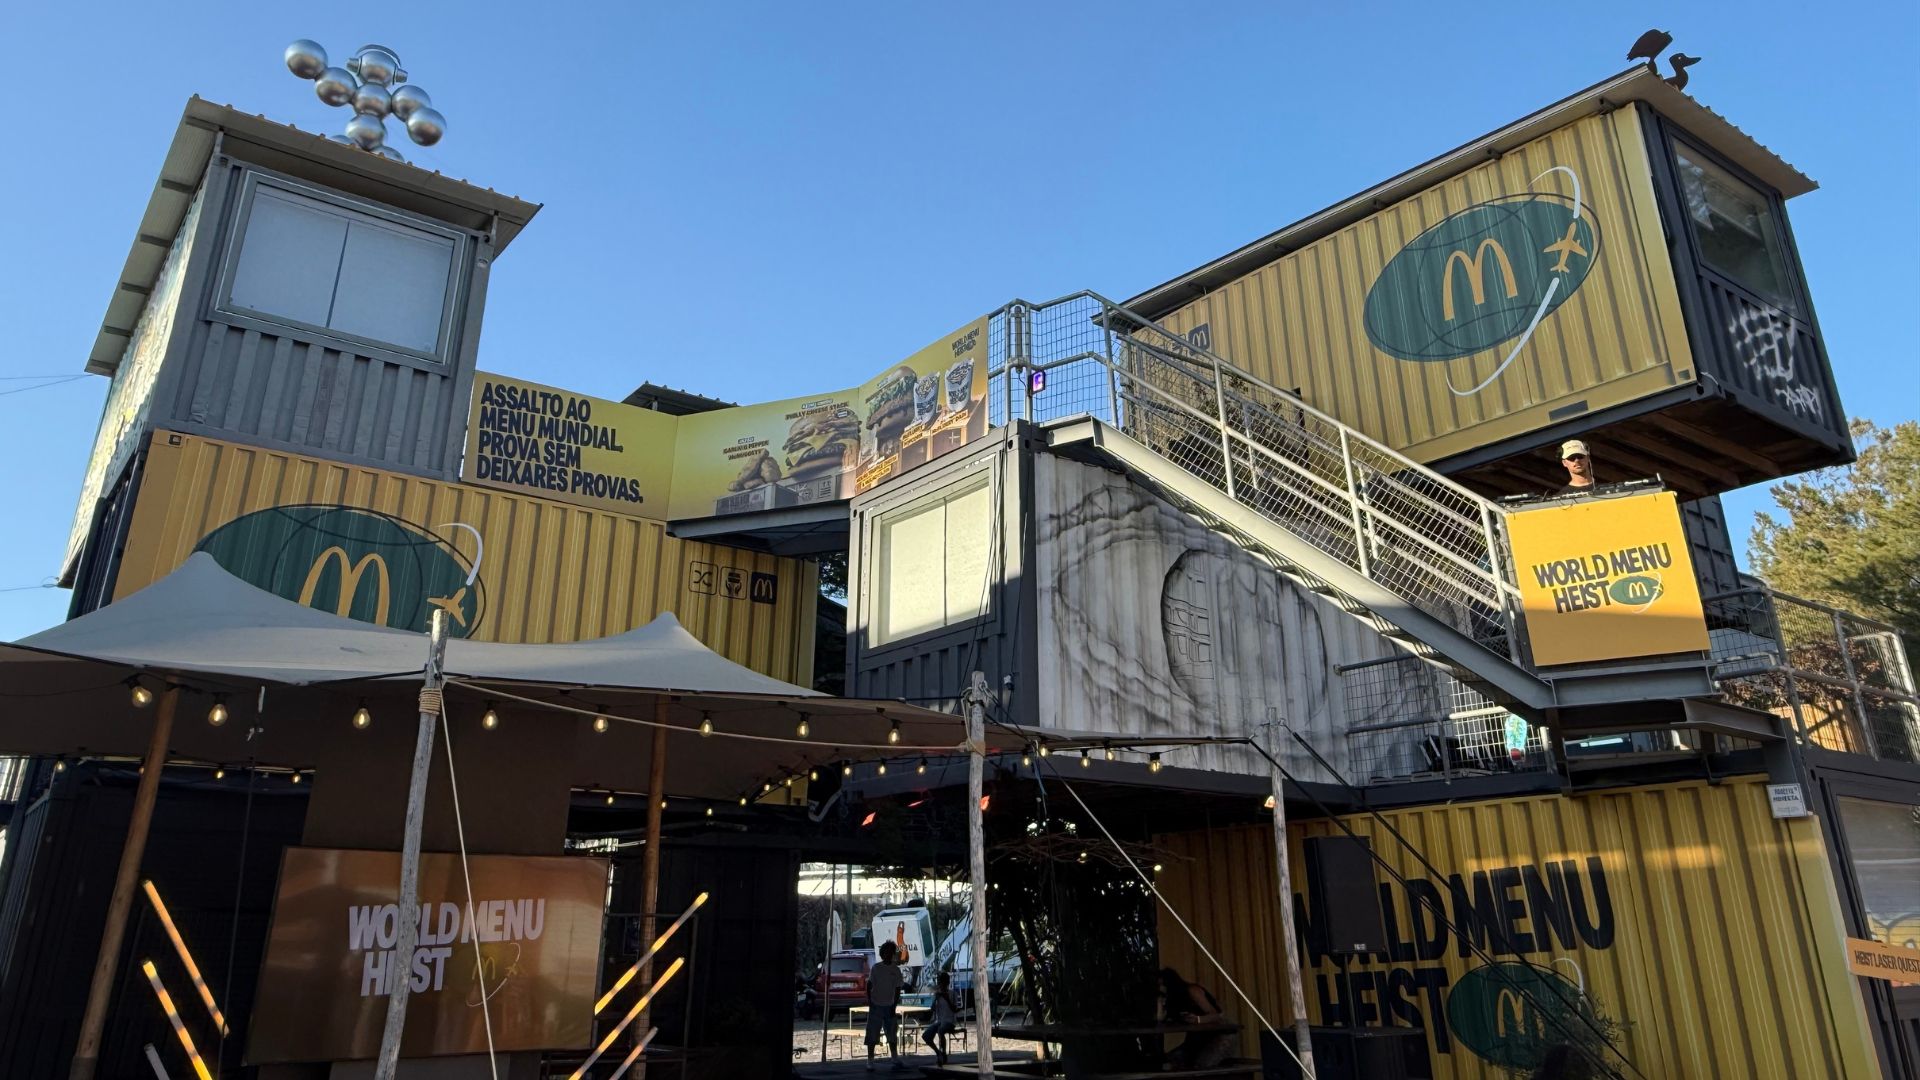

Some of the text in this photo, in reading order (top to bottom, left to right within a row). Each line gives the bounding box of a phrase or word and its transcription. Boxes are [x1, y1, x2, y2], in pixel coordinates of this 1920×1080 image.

[481, 382, 591, 422] ASSALTO AO
[478, 430, 581, 470] PROVA SEM
[479, 406, 624, 453] MENU MUNDIAL.
[476, 454, 644, 504] DEIXARES PROVAS.
[1532, 542, 1672, 588] WORLD MENU
[1552, 581, 1612, 614] HEIST
[348, 898, 545, 950] WOLD MENU
[1449, 856, 1615, 958] MENU
[360, 947, 452, 997] HST
[1854, 950, 1873, 967] HEIST
[1873, 952, 1898, 970] LASER
